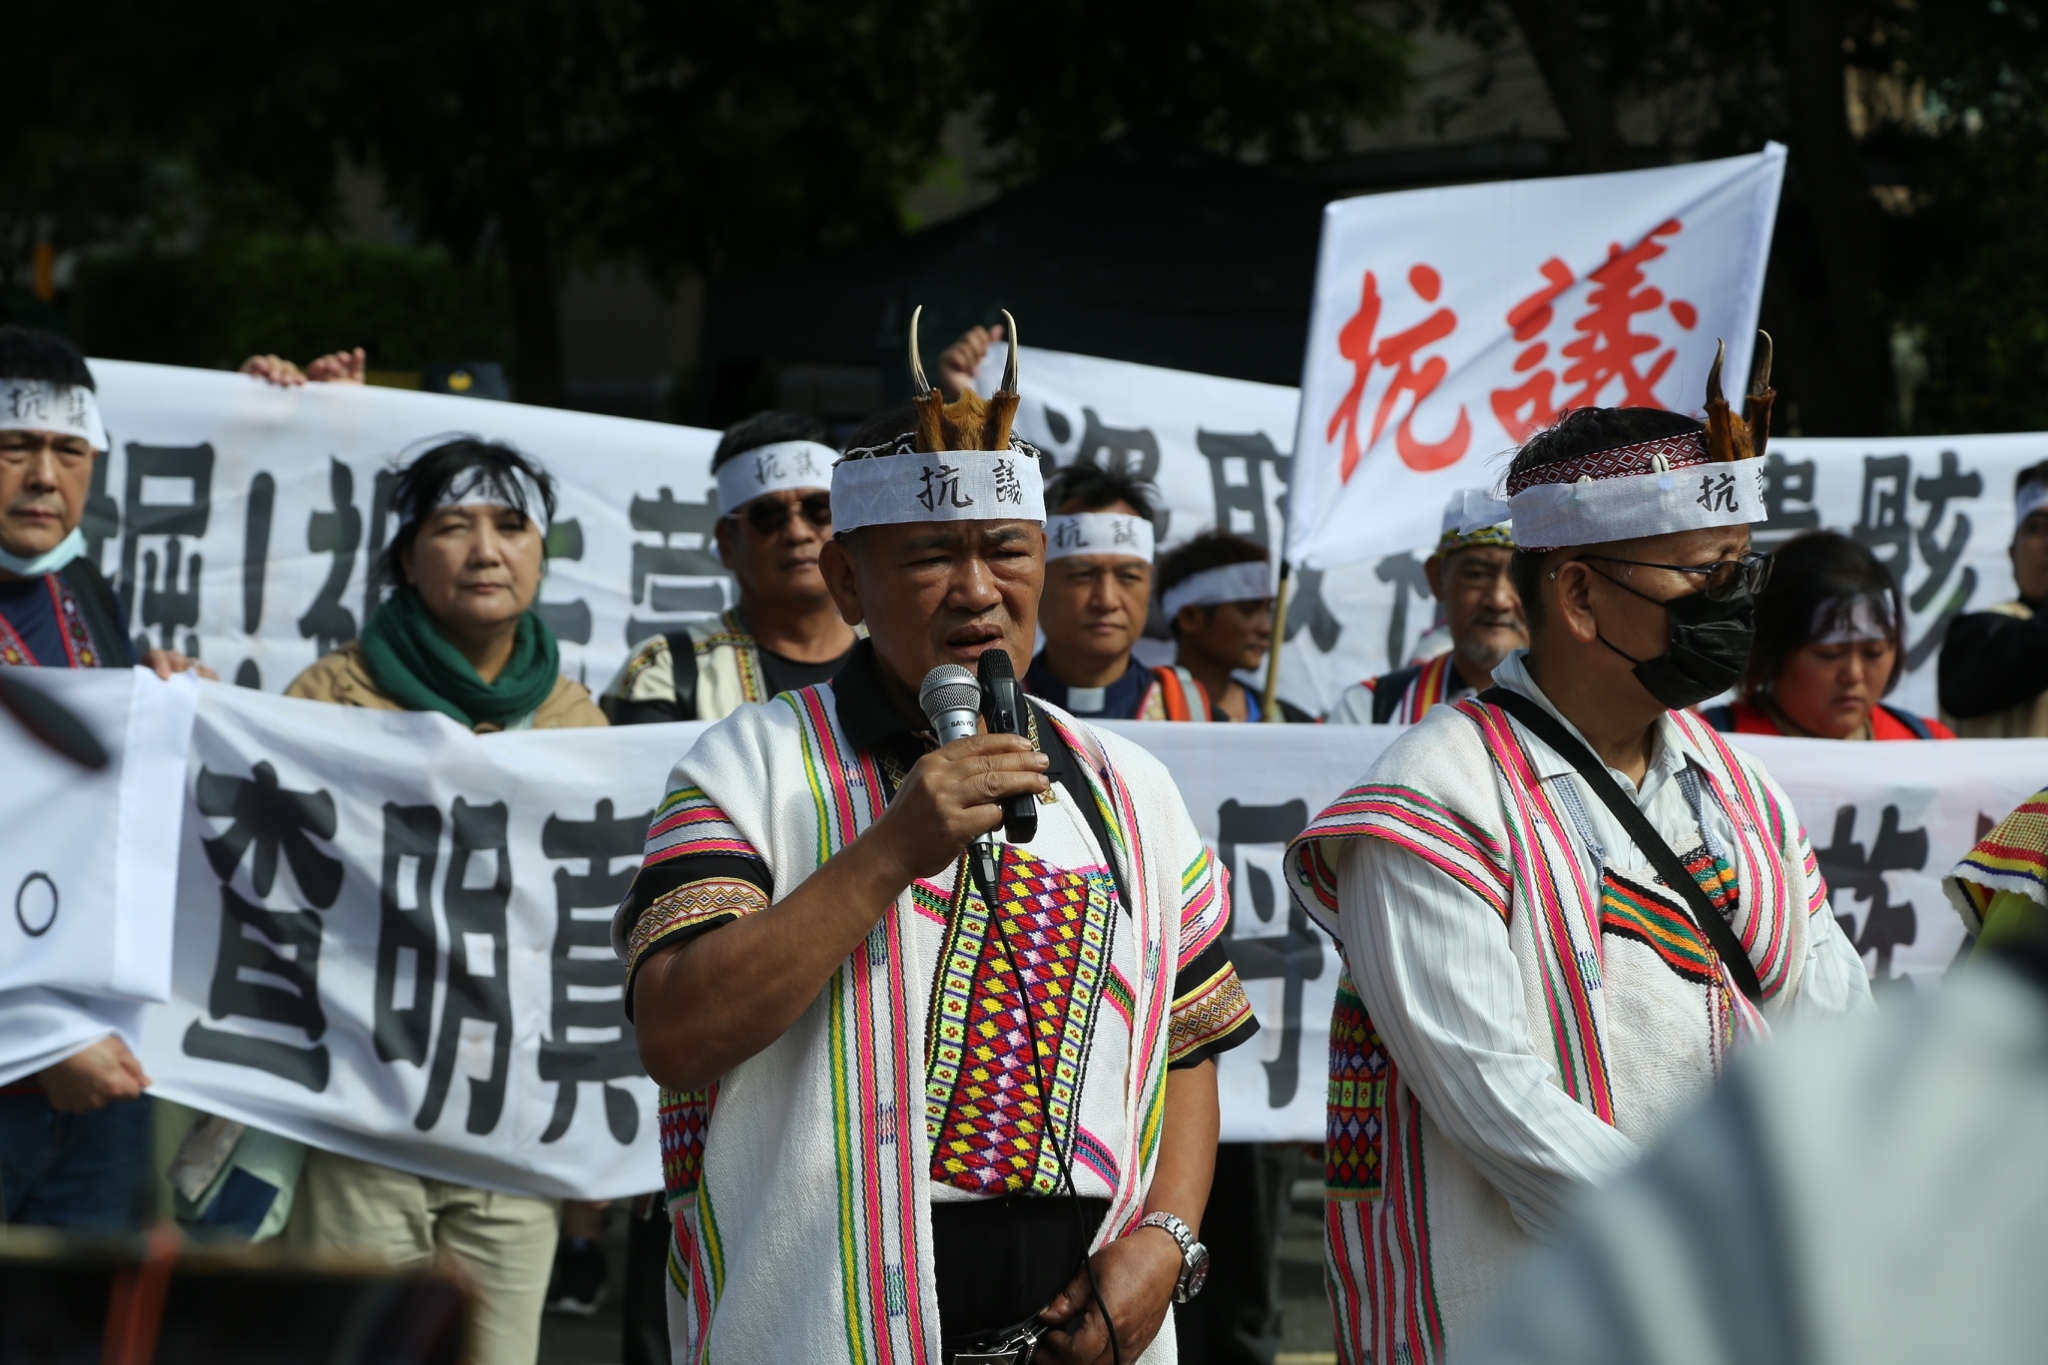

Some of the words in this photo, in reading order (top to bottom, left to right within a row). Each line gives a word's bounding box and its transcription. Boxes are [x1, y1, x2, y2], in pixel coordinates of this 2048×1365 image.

[1327, 218, 1698, 487] 抗議
[753, 447, 821, 485] 抗議
[916, 458, 1023, 512] 抗議
[1052, 517, 1138, 548] 抗議
[950, 720, 974, 728] SANYO
[181, 760, 662, 1146] 查明真
